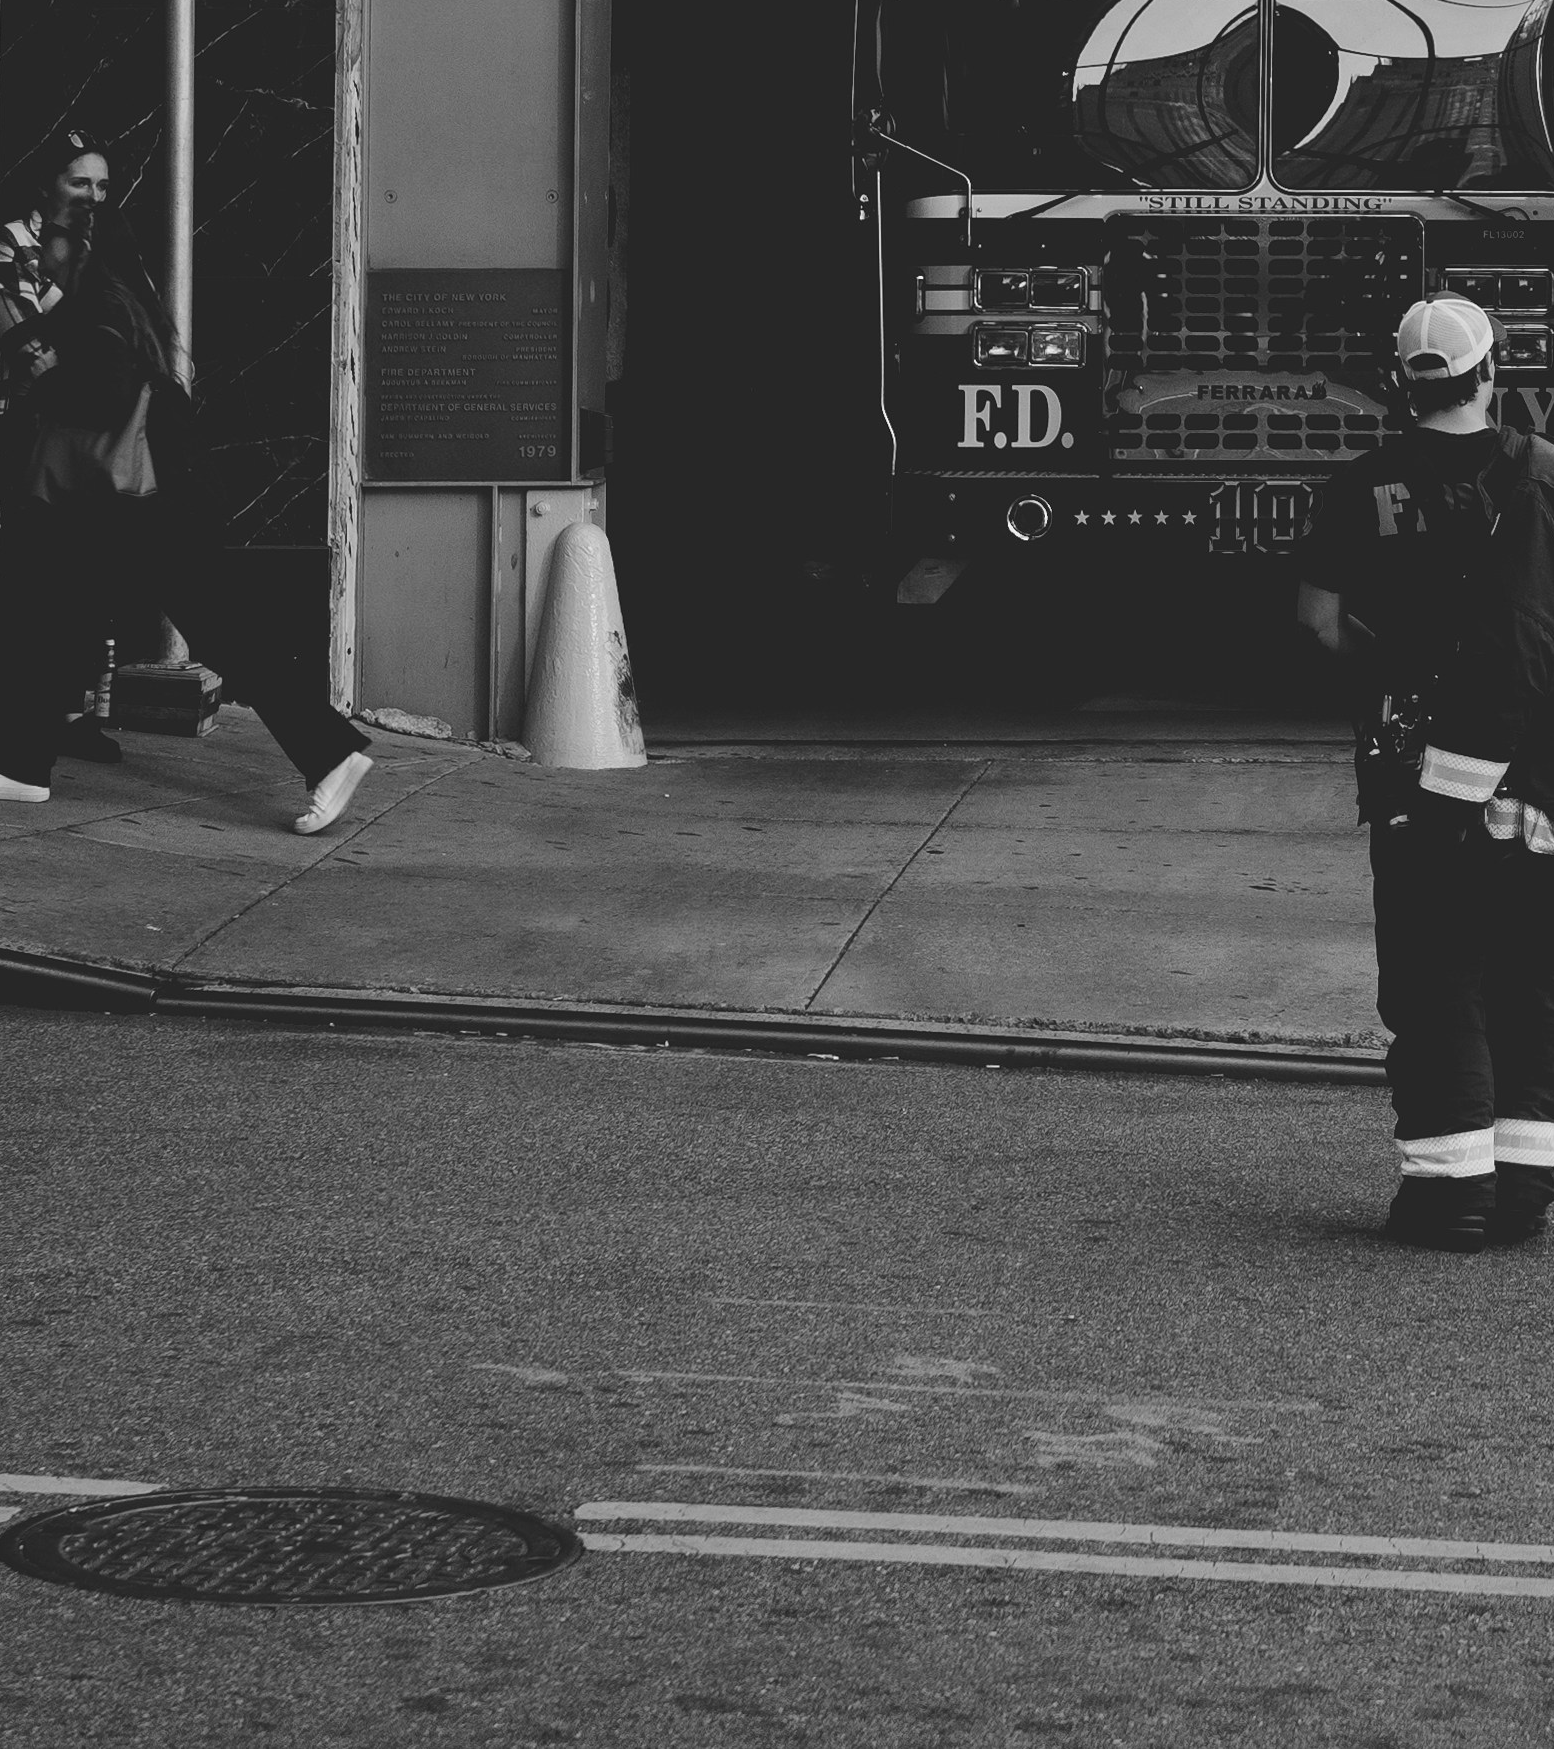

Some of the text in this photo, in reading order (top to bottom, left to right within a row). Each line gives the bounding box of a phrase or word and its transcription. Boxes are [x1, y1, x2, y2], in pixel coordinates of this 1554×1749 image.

[1139, 197, 1393, 211] "STILL STANDING"
[1483, 230, 1525, 239] FL13002
[382, 293, 507, 301] THE CITY OF NEW YORK
[381, 368, 476, 376] FIRE DEPARTMENT
[1197, 384, 1307, 400] FERRARA
[381, 403, 557, 411] DEPARTMENT OF GENERAL SERVICES
[958, 385, 1074, 449] F.D.
[519, 445, 557, 458] 1979
[1208, 481, 1314, 554] 10
